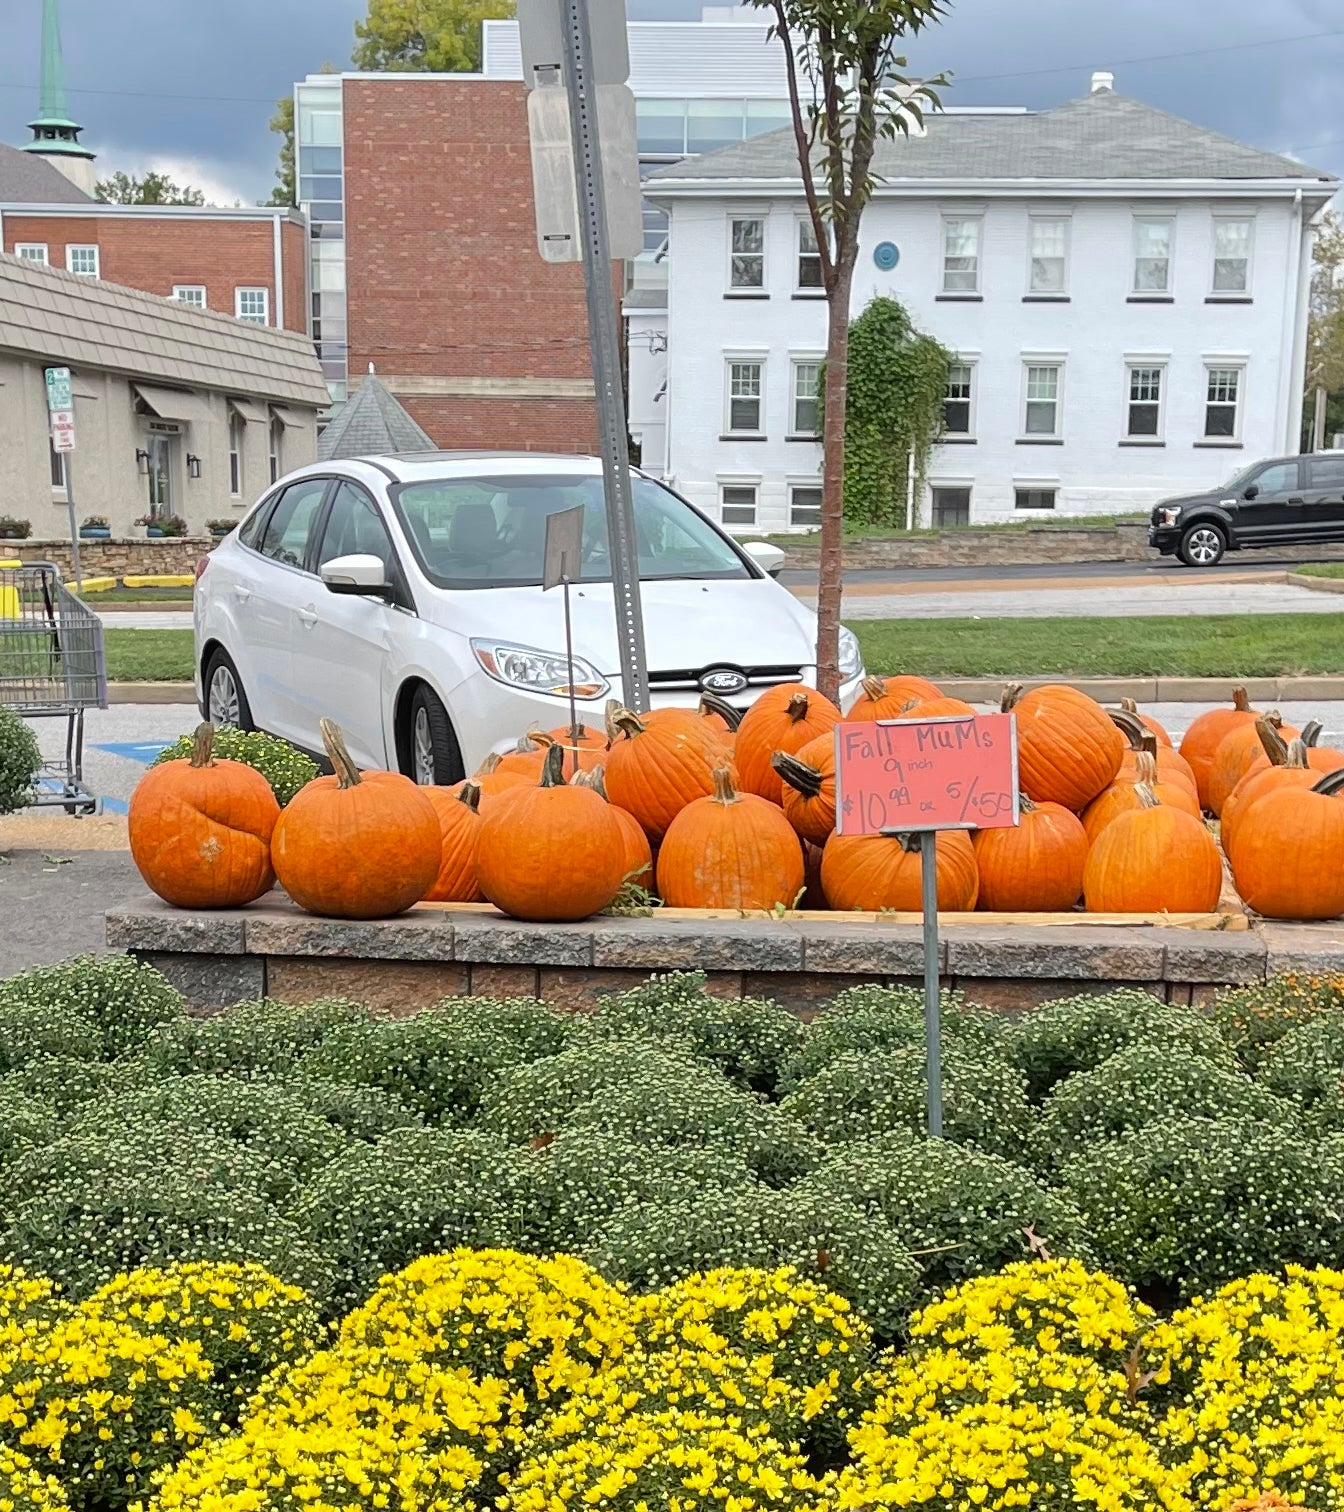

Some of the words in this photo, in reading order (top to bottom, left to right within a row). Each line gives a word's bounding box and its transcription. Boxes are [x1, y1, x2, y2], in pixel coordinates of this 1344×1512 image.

[845, 727, 894, 761] Fall
[884, 758, 905, 783] 9
[907, 758, 934, 773] inch
